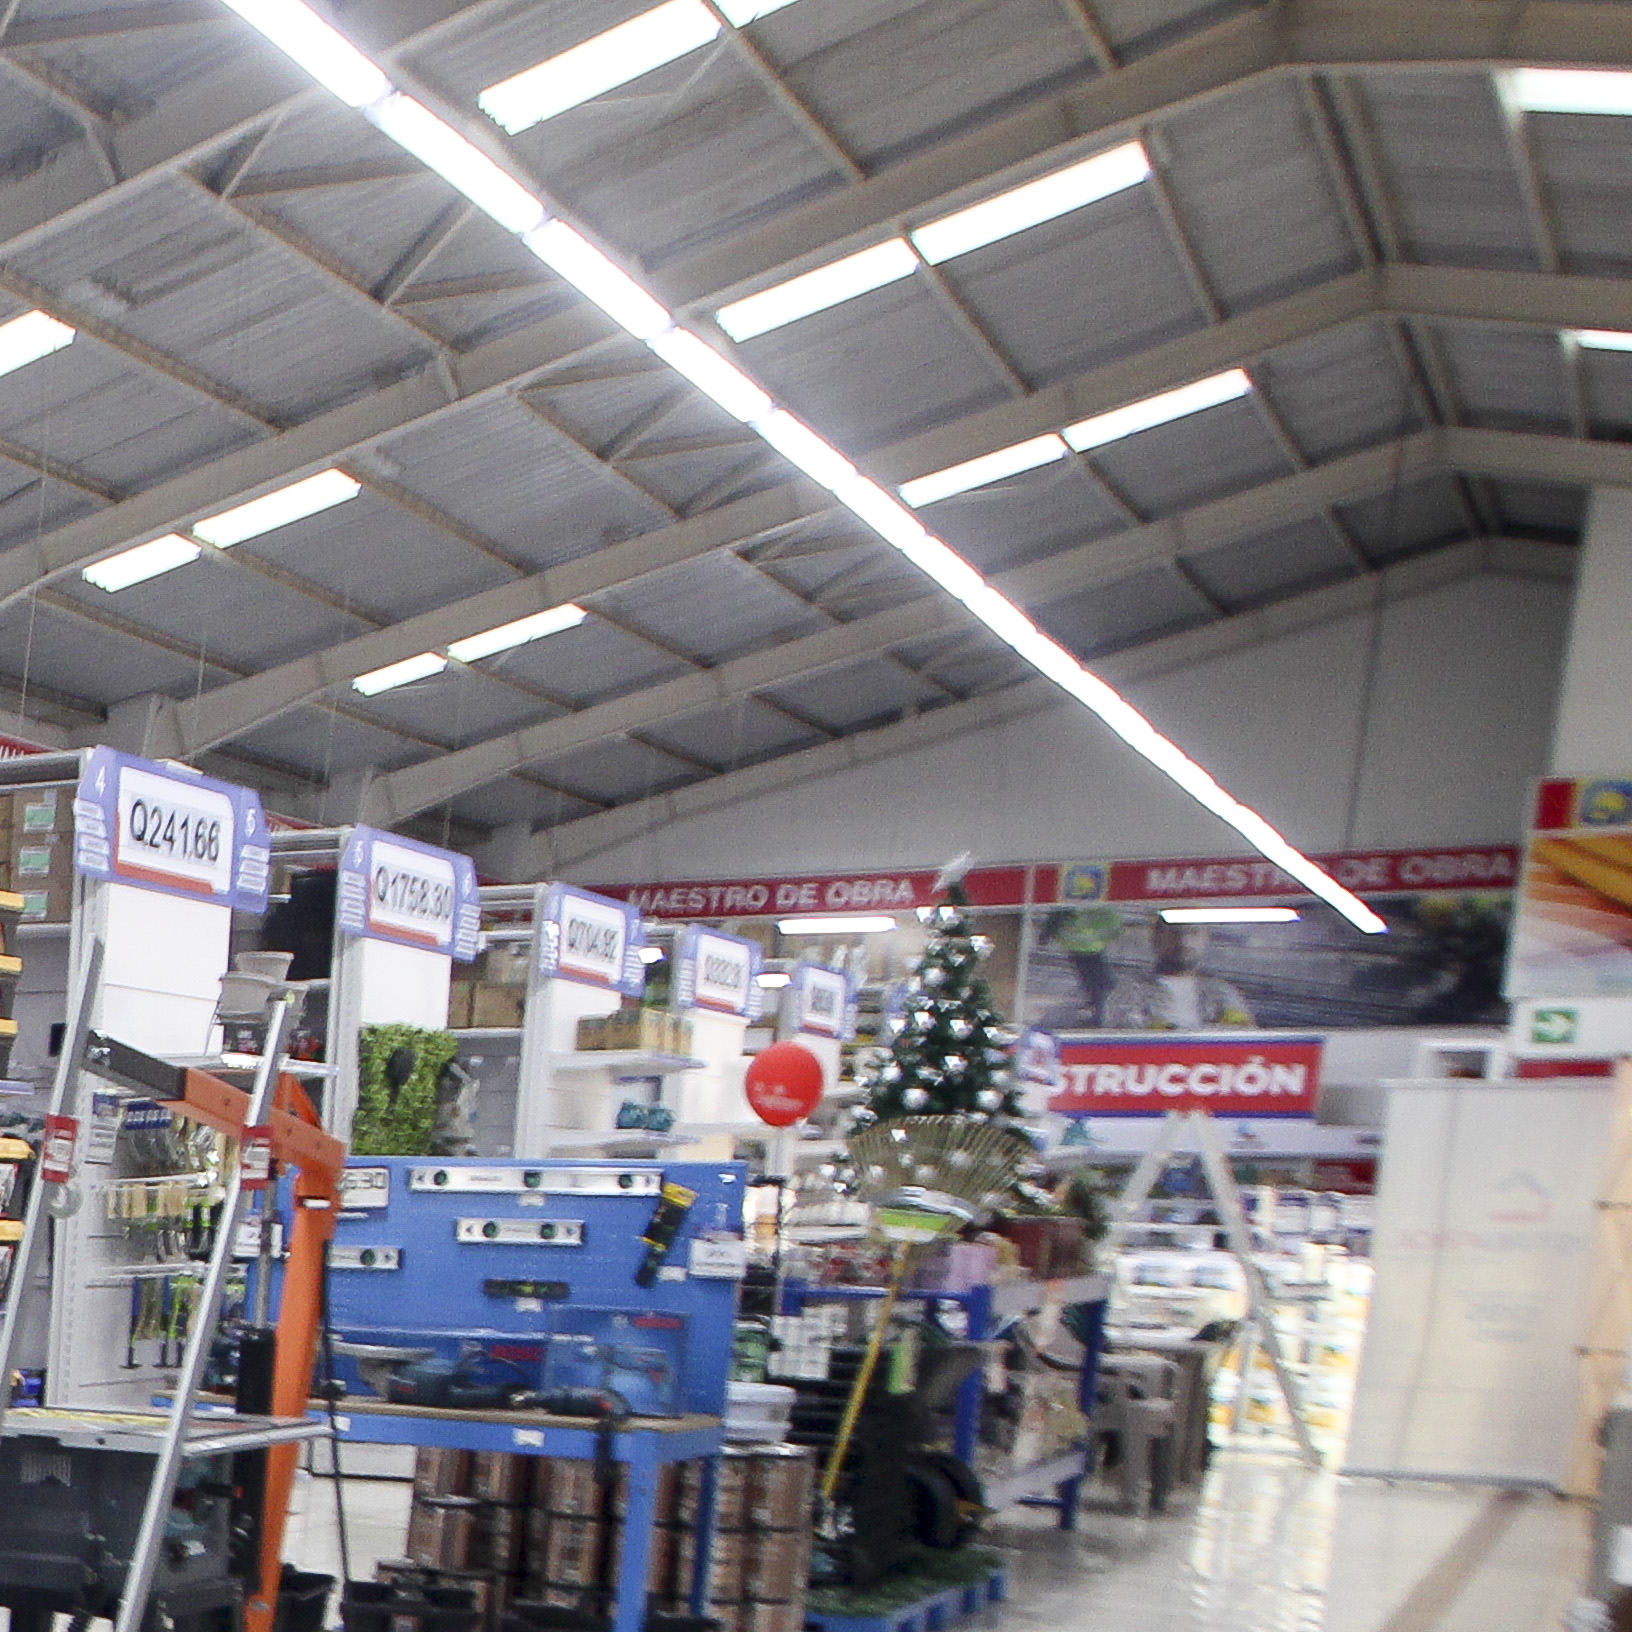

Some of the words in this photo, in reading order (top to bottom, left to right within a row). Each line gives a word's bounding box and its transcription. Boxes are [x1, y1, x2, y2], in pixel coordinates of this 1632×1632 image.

[94, 766, 107, 797] 4
[776, 882, 820, 907] DE
[826, 878, 916, 905] OBRA
[1146, 864, 1312, 893] MAEST
